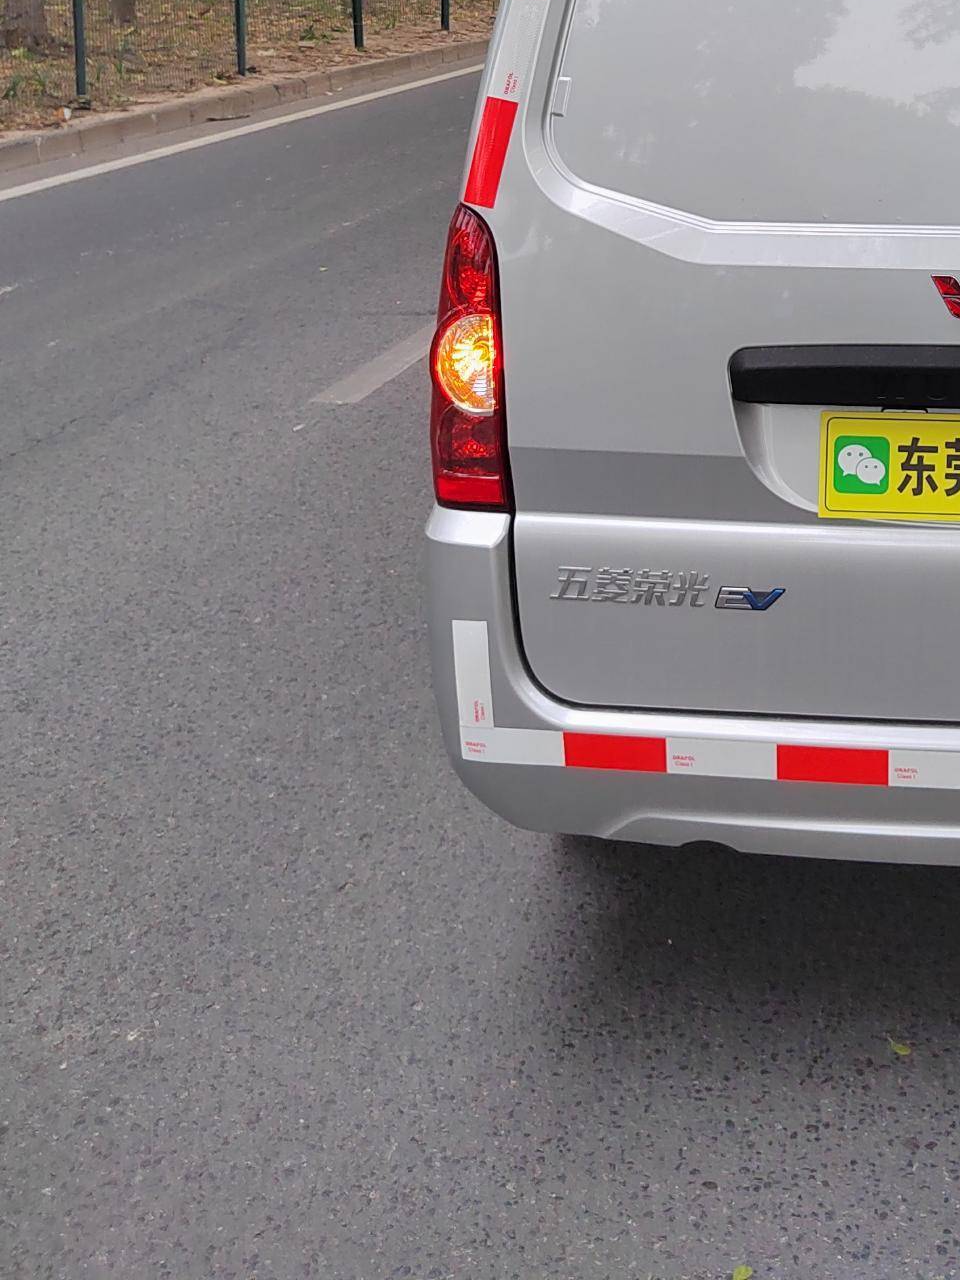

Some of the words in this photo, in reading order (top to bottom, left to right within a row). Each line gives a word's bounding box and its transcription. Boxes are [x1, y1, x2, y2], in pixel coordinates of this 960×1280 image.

[550, 566, 710, 607] 五菱荣光
[715, 586, 787, 611] EV
